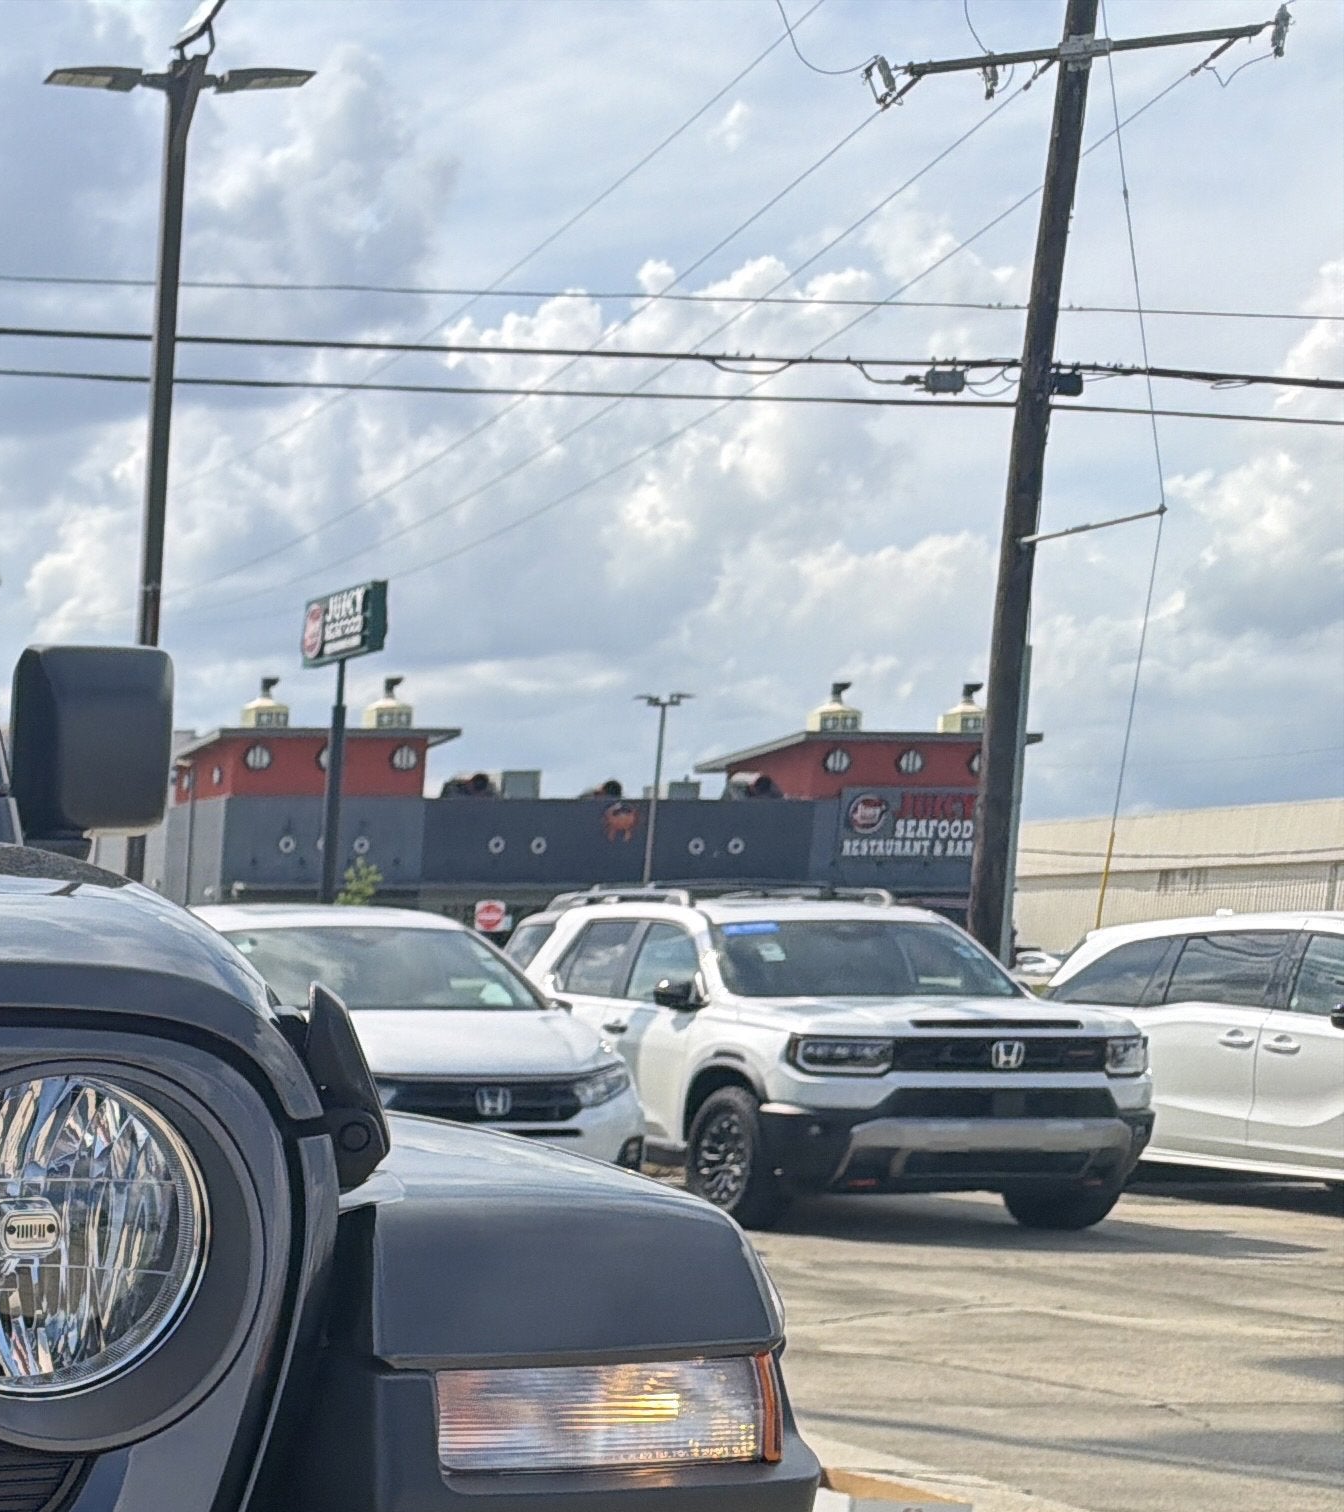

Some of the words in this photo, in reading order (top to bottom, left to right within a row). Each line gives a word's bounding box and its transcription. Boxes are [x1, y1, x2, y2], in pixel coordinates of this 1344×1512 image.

[325, 586, 366, 623] JUICY
[896, 793, 977, 820] JUICY
[894, 818, 974, 839] SEAFOOD
[841, 838, 930, 857] RESTAURANT
[933, 840, 943, 857] &
[945, 840, 973, 857] BAR
